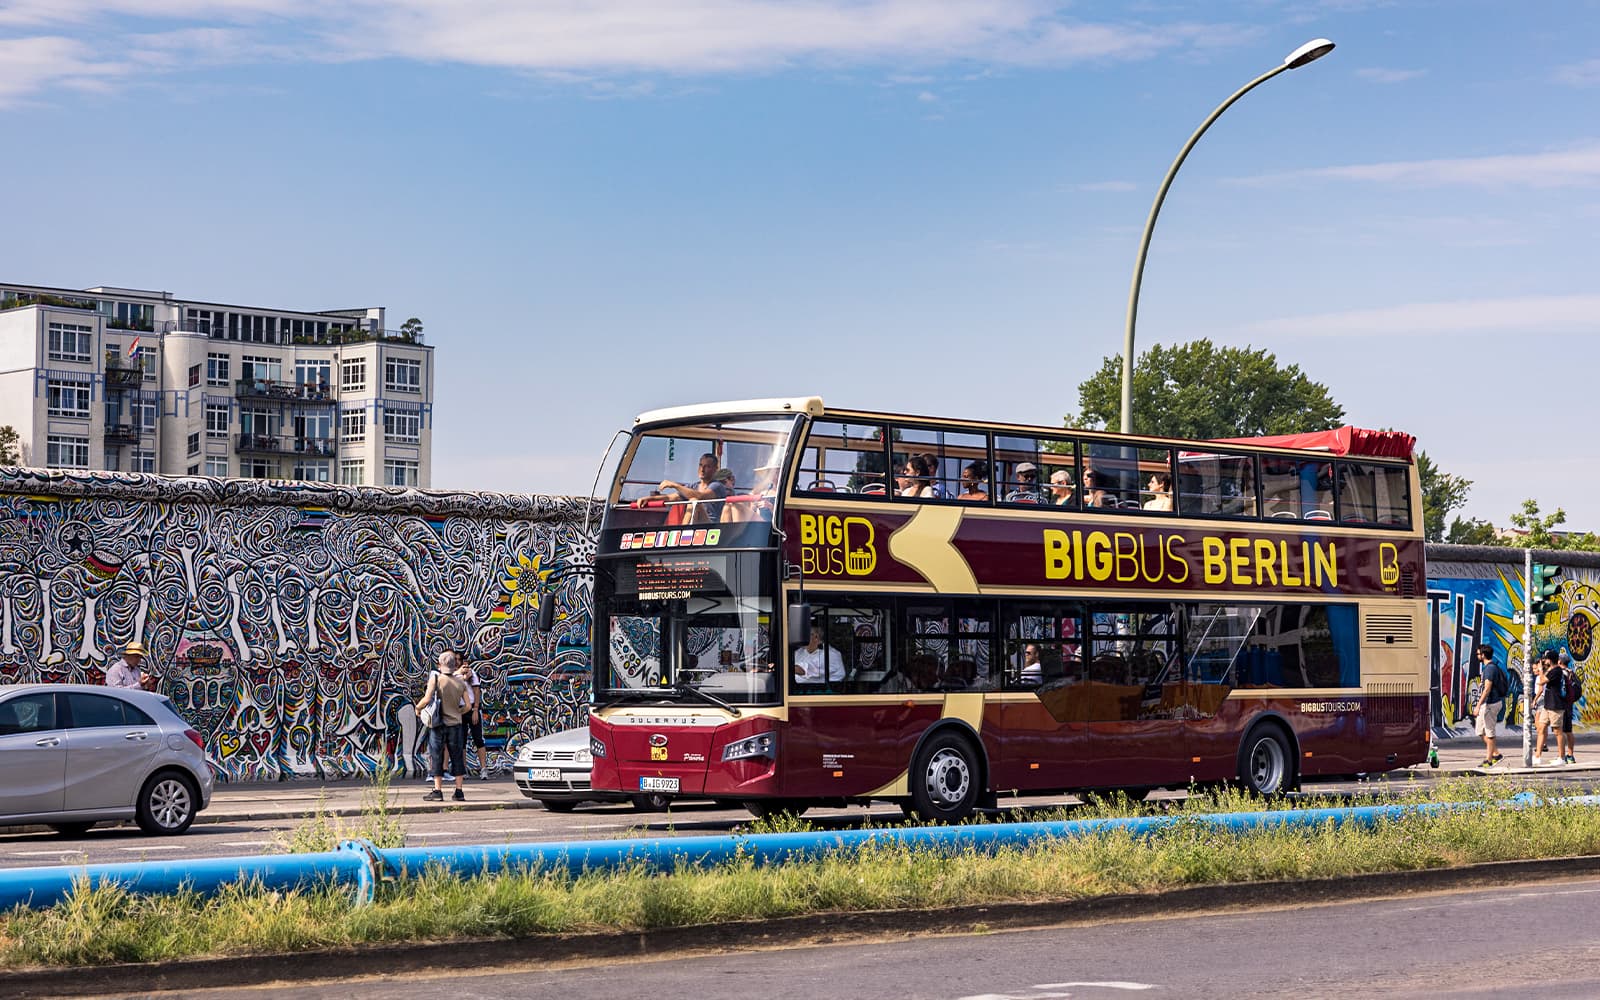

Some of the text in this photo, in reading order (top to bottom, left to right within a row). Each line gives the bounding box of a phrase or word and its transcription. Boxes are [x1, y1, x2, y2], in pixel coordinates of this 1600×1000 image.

[800, 514, 843, 546] BIG
[801, 546, 844, 575] BUS
[1202, 536, 1338, 588] BERLIN
[638, 590, 691, 600] BIGBUSTOURS.COM
[1300, 702, 1361, 712] BIGBUSTOURS.COM
